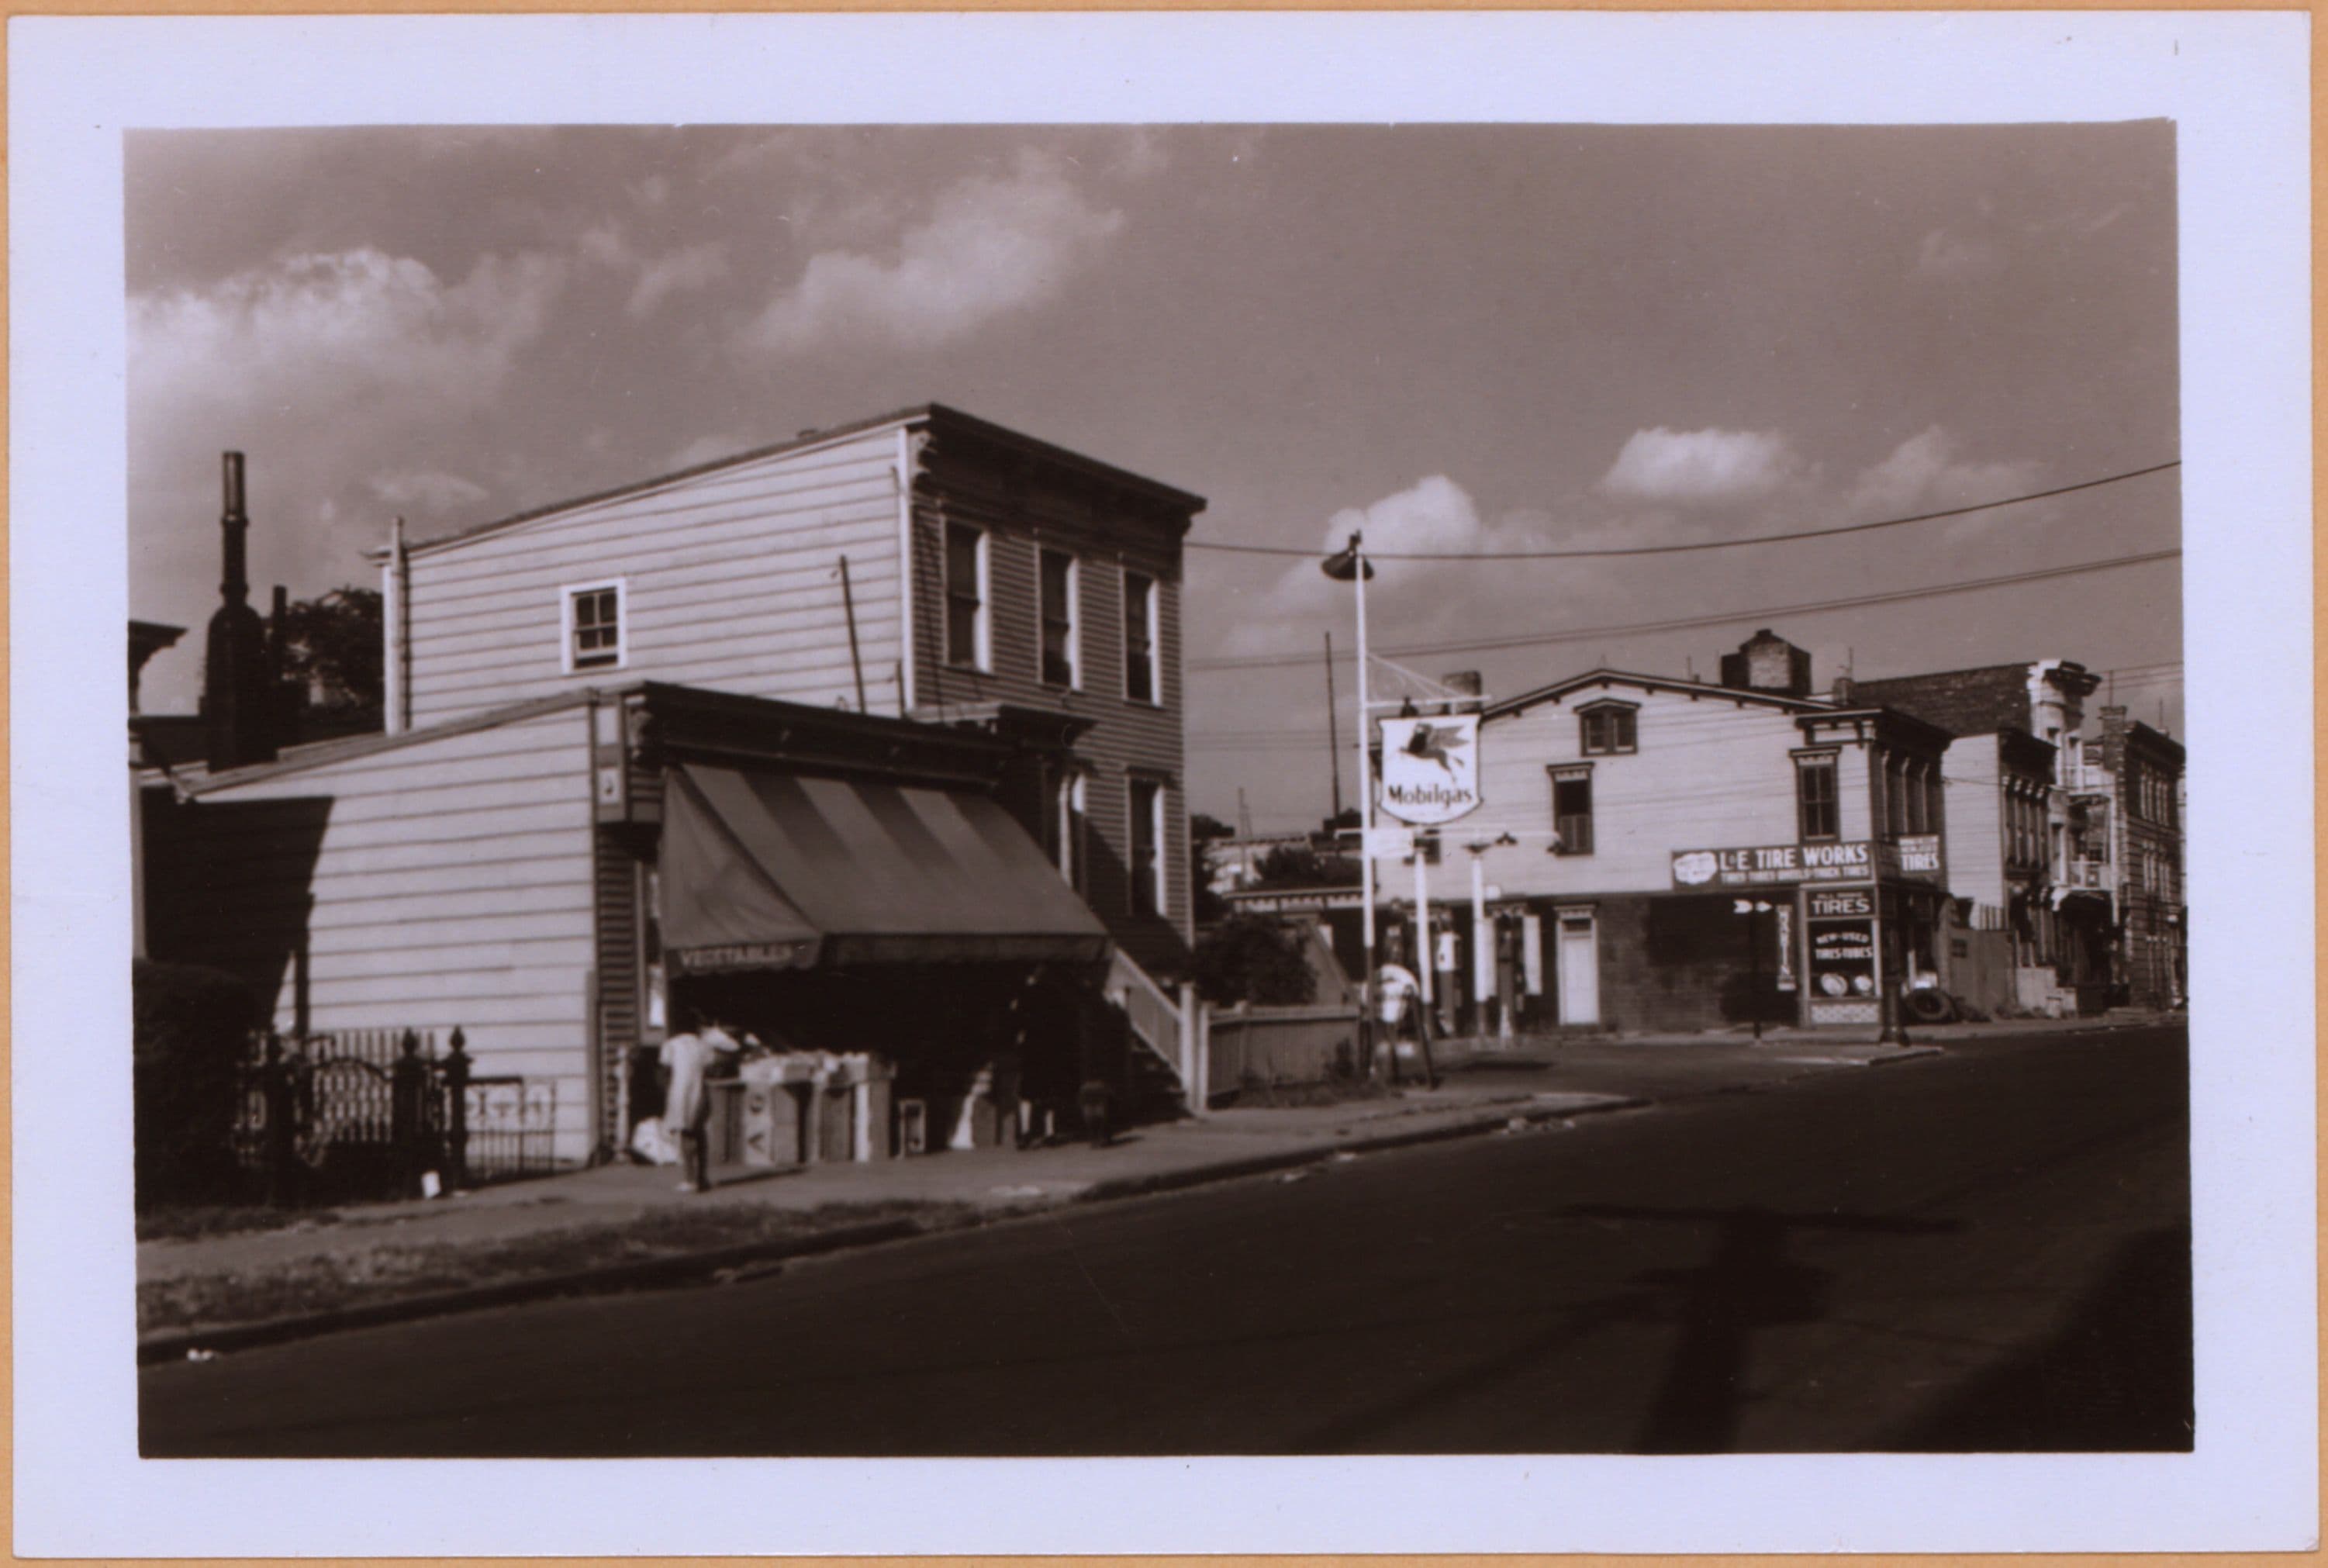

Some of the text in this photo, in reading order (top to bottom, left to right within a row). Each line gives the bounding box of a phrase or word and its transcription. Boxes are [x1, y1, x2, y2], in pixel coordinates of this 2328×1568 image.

[1388, 783, 1472, 809] Mobilgas
[1755, 848, 1796, 869] TIRE
[1802, 843, 1868, 867] WORKS
[1901, 852, 1939, 871] TIRES
[1811, 898, 1870, 915] TIRES
[680, 945, 793, 966] VEGETABLES
